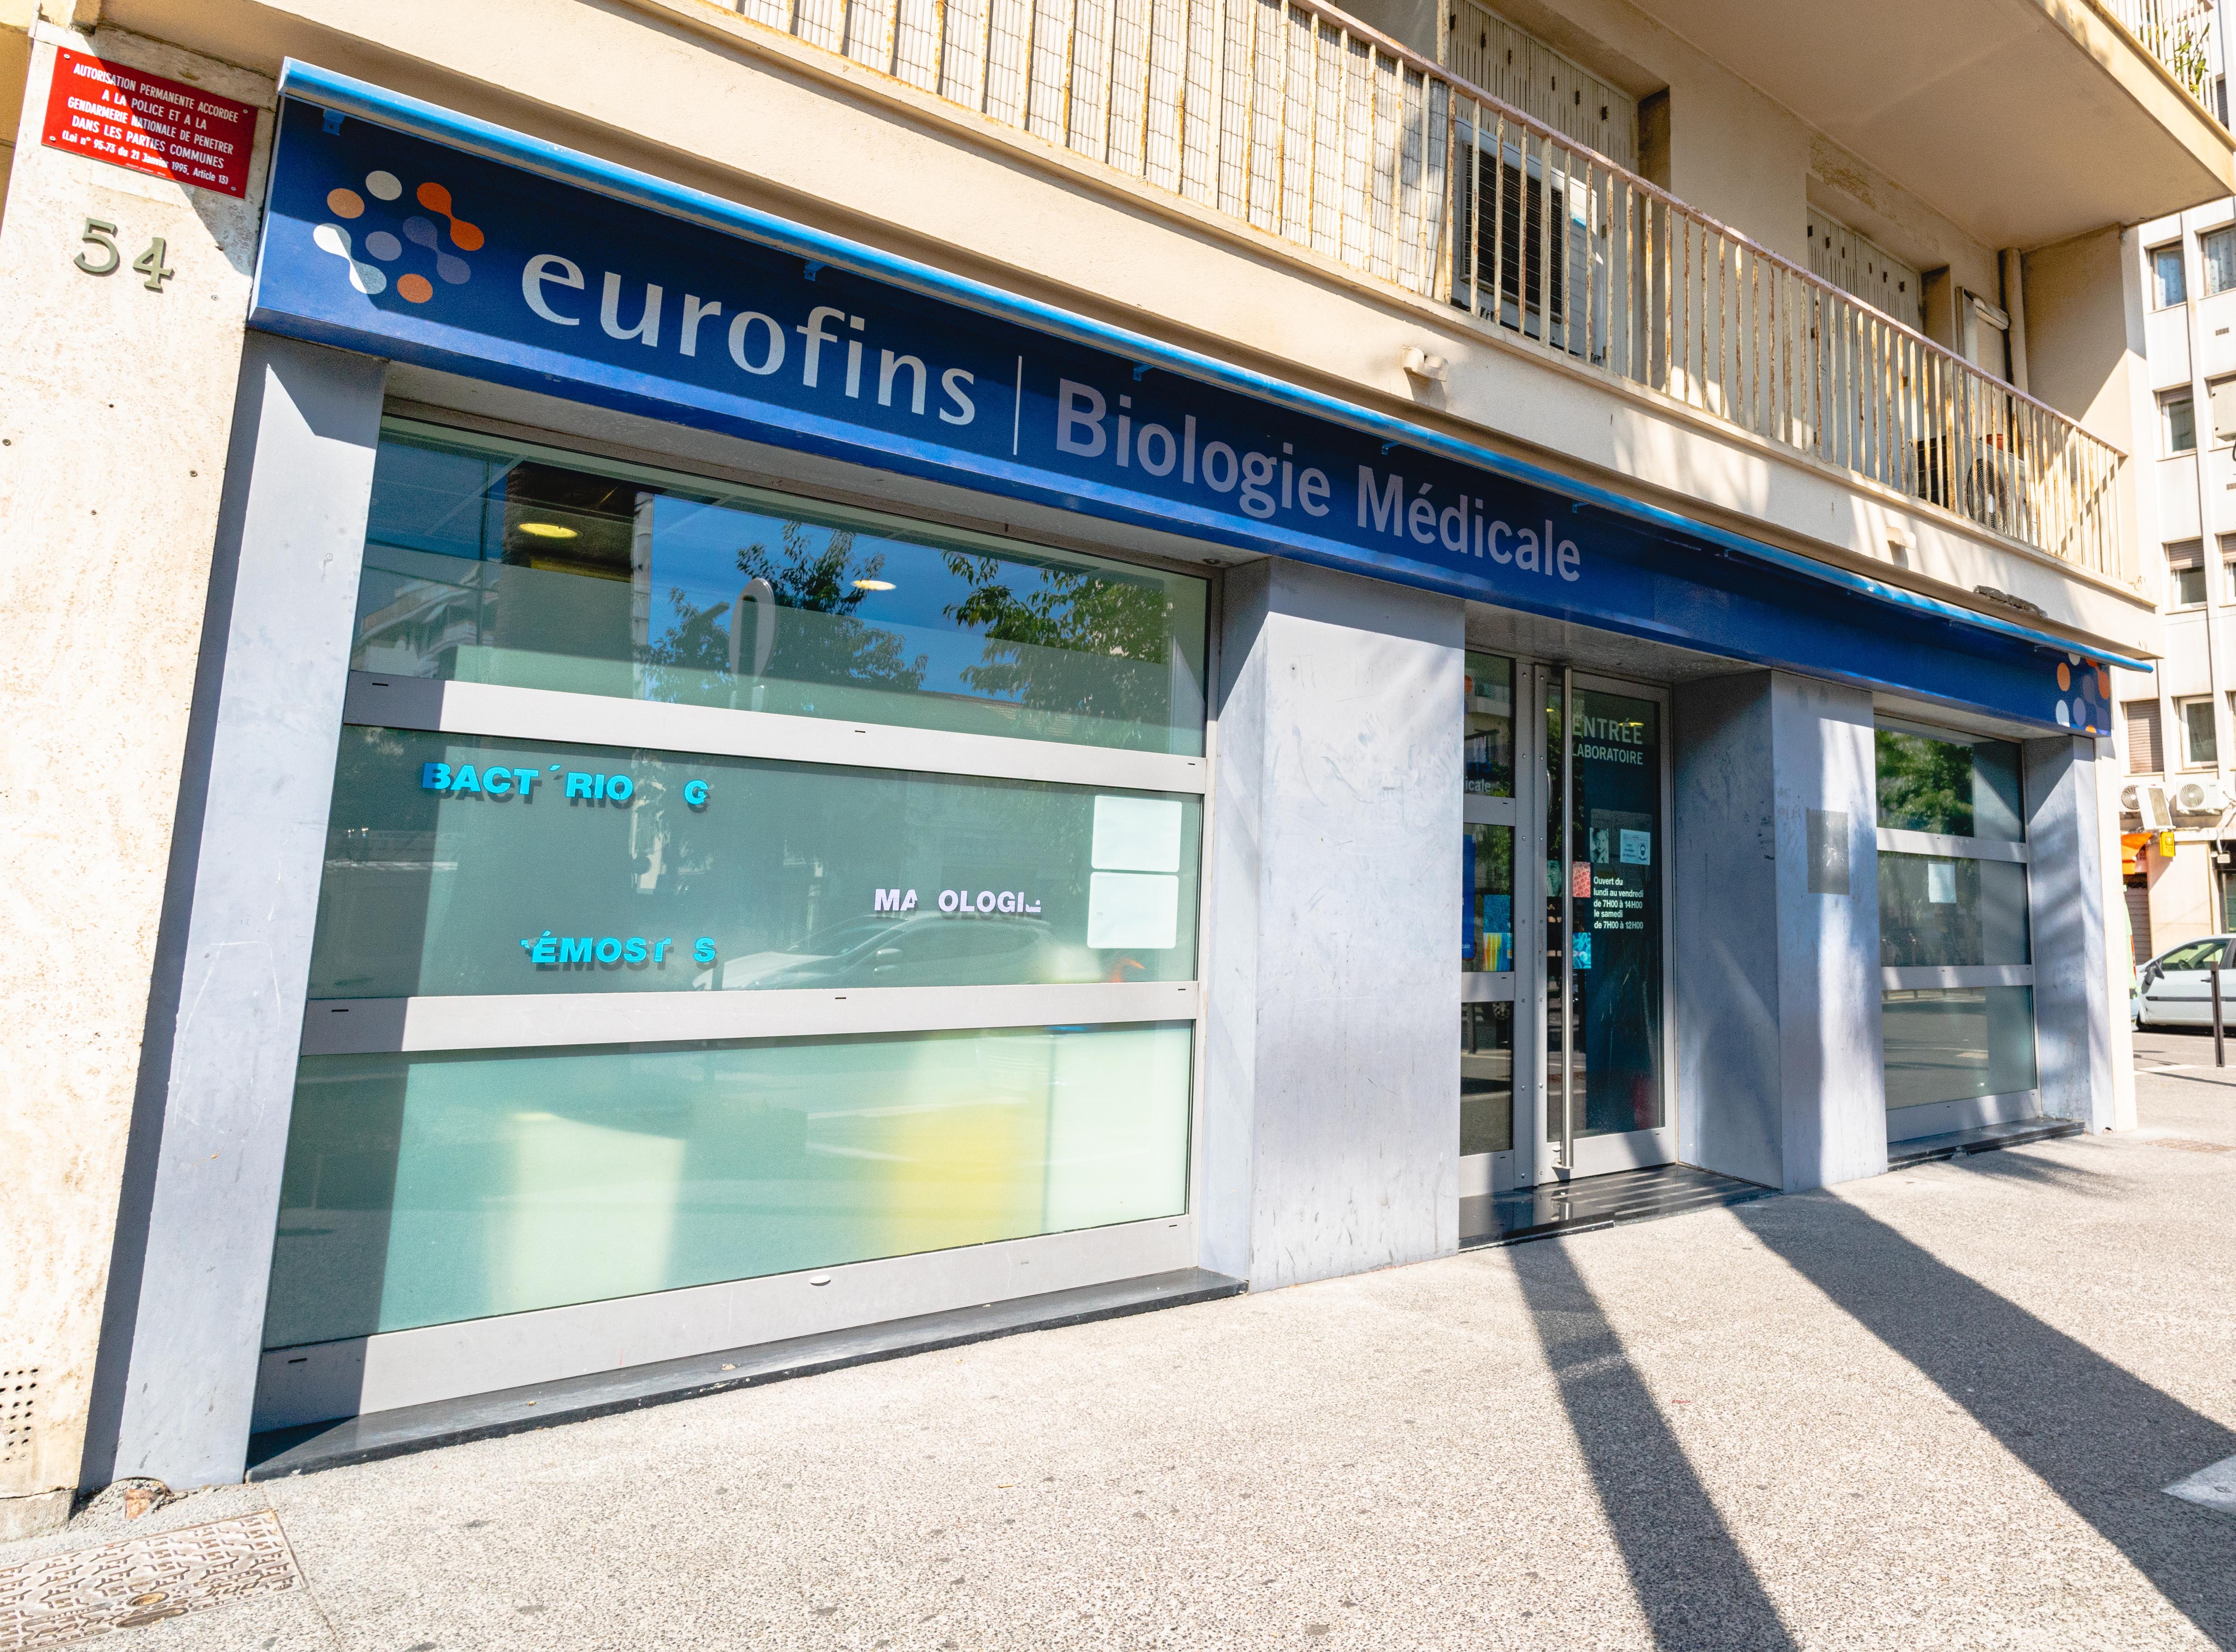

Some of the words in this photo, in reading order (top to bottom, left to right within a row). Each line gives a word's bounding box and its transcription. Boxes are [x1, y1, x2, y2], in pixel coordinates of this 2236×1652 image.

[73, 63, 137, 92] AUTORISATION
[140, 83, 195, 110] PERMANENTE
[197, 101, 239, 123] ACCORDEE
[101, 89, 110, 101] A
[113, 92, 127, 106] LA
[131, 98, 165, 117] POLICE
[168, 109, 181, 122] ET
[183, 114, 191, 125] A
[195, 117, 207, 130] LA
[67, 96, 128, 124] GENDARMERIE
[131, 115, 177, 138] NATIONALE
[179, 129, 191, 142] DE
[194, 133, 234, 155] PENETRER
[71, 115, 100, 133] DANS
[103, 124, 123, 140] LES
[126, 131, 166, 152] PARTIES
[169, 144, 224, 169] COMMUNES
[80, 137, 91, 145] n°
[93, 139, 116, 153] 95-73
[118, 146, 129, 157] du
[130, 149, 140, 160] 21
[142, 152, 169, 168] Janvier
[192, 167, 216, 182] Article
[218, 175, 229, 185] 13)
[73, 217, 174, 292] 54
[522, 253, 976, 426] eurofins
[1056, 377, 1331, 519] Biologie
[1357, 464, 1581, 581] Médicale
[1572, 714, 1643, 745] ENTRÉE
[1572, 743, 1643, 765] LABORATOIRE
[1593, 876, 1614, 885] Ouvert
[1594, 888, 1608, 896] lundi
[1594, 909, 1600, 917] le
[1603, 900, 1618, 908] 7H00
[1594, 921, 1602, 929] de
[1625, 921, 1643, 929] 12H00
